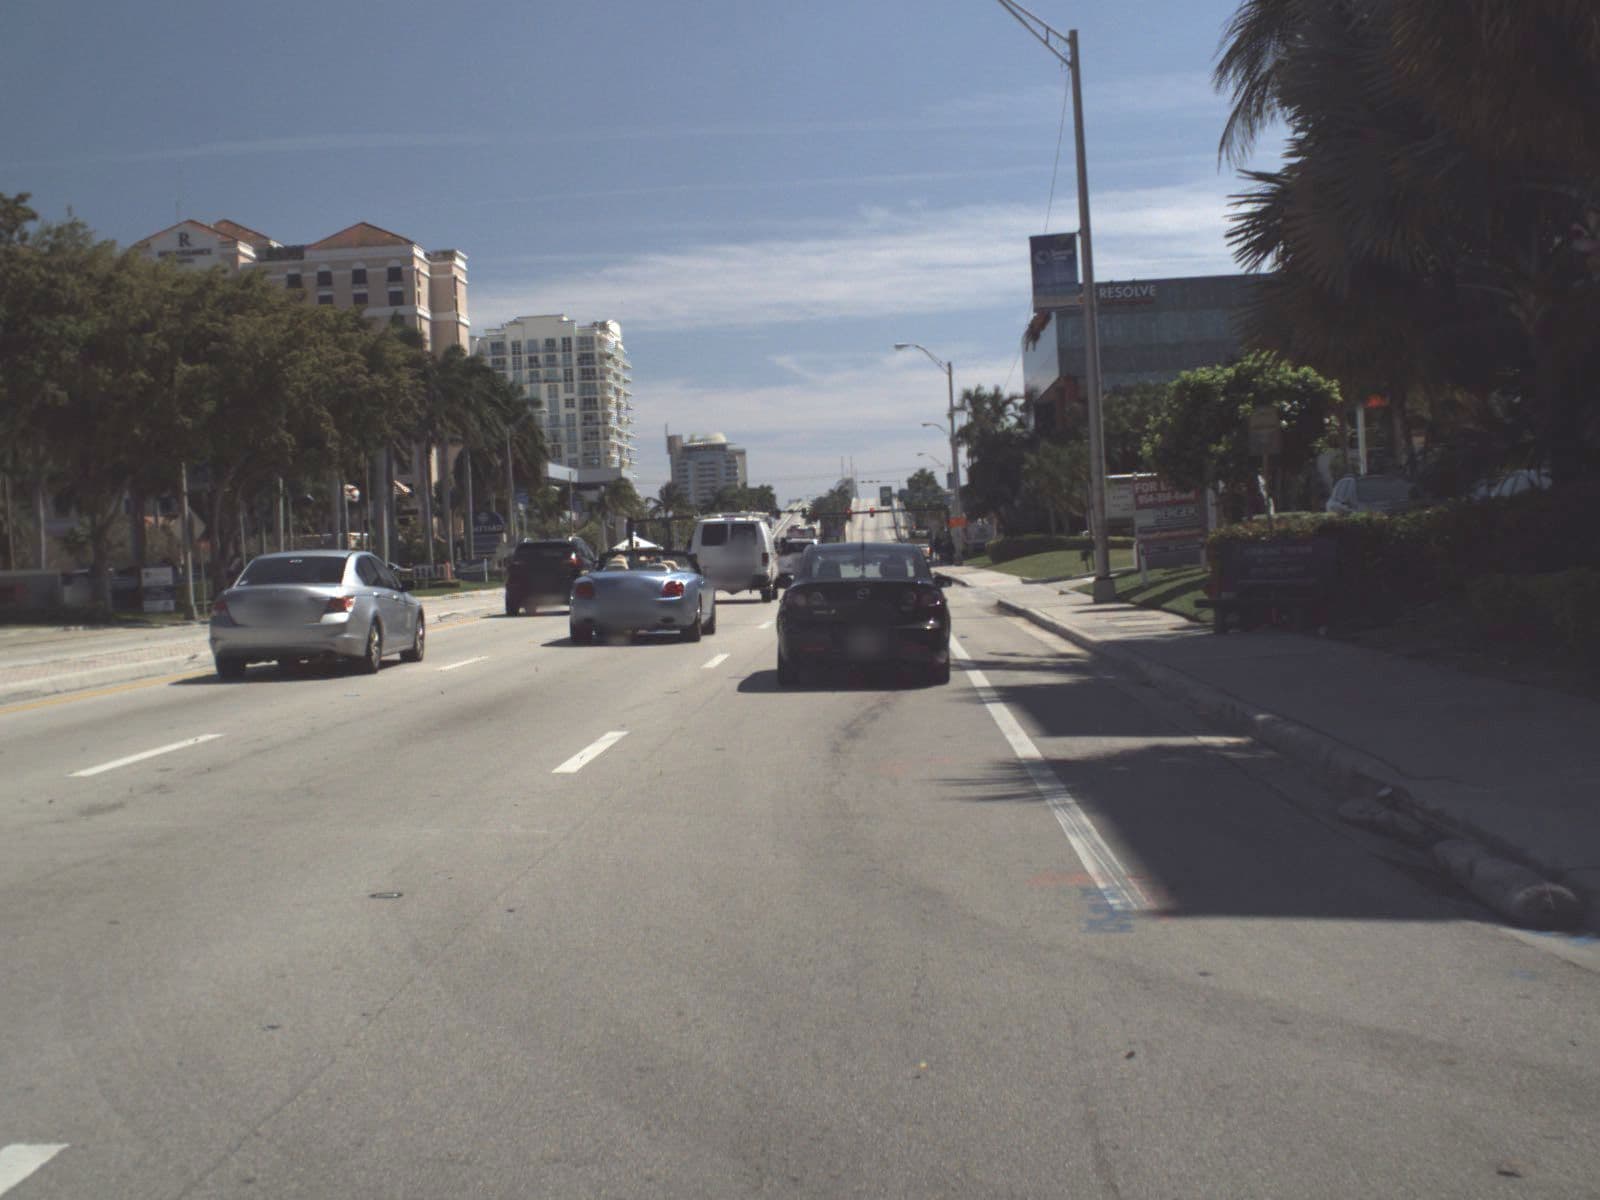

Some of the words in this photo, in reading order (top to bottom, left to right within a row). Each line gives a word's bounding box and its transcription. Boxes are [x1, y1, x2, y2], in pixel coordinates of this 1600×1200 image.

[178, 232, 193, 247] R
[1098, 285, 1157, 299] RESOLVE
[1134, 481, 1158, 493] FOR
